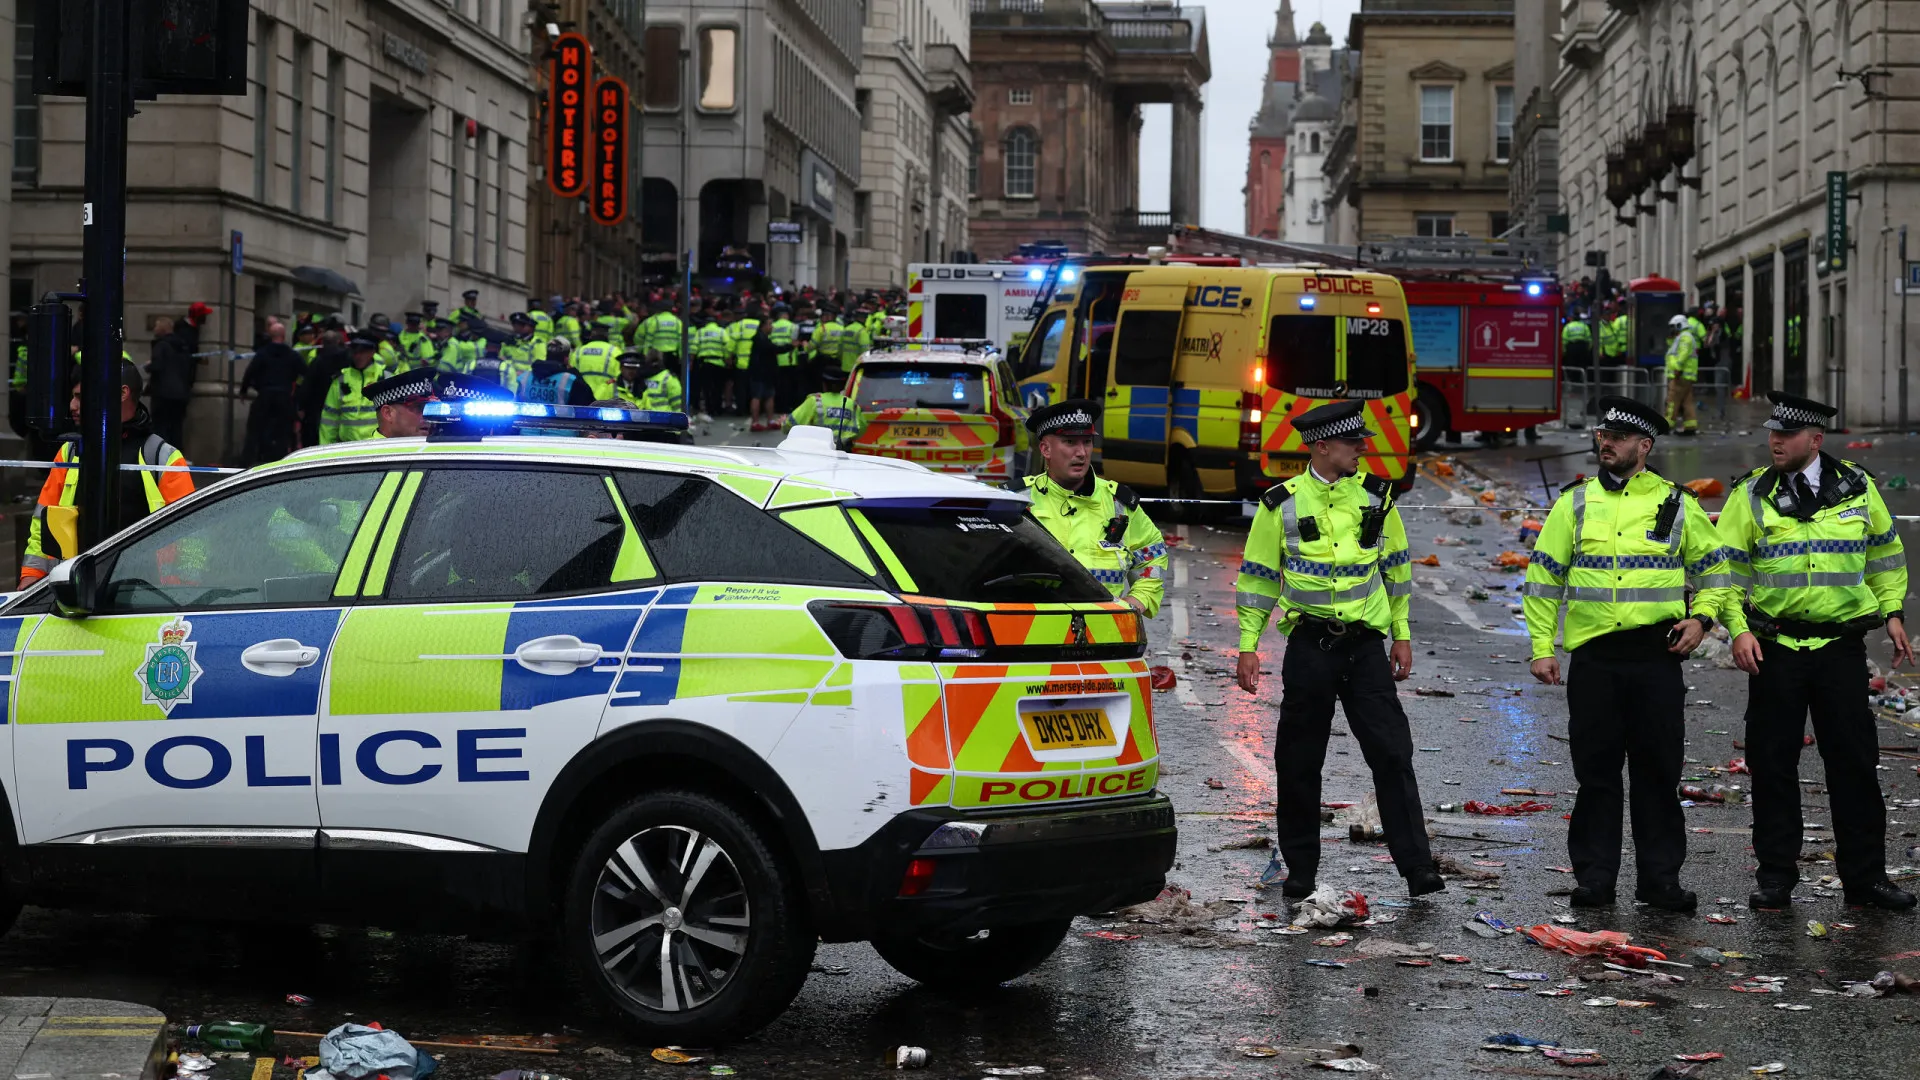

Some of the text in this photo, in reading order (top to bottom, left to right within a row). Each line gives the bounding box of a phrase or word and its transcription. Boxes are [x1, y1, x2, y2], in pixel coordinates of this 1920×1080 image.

[561, 47, 579, 188] HOOTERS
[602, 89, 618, 217] HOOTERS
[1833, 175, 1843, 256] MERSEYRAIL
[1303, 278, 1374, 295] POLICE
[1191, 285, 1243, 308] ICE
[1005, 305, 1015, 315] St
[1346, 317, 1389, 336] MP28
[1296, 387, 1333, 398] MATRIX
[1347, 387, 1384, 398] MATRIX
[893, 426, 921, 436] KX24
[724, 586, 756, 594] Report
[154, 686, 181, 698] POLICE
[1026, 680, 1125, 695] www.merseyside.police.uk
[1033, 712, 1107, 743] DK19 DHX
[66, 728, 530, 790] POLICE
[979, 769, 1146, 802] POLICE
